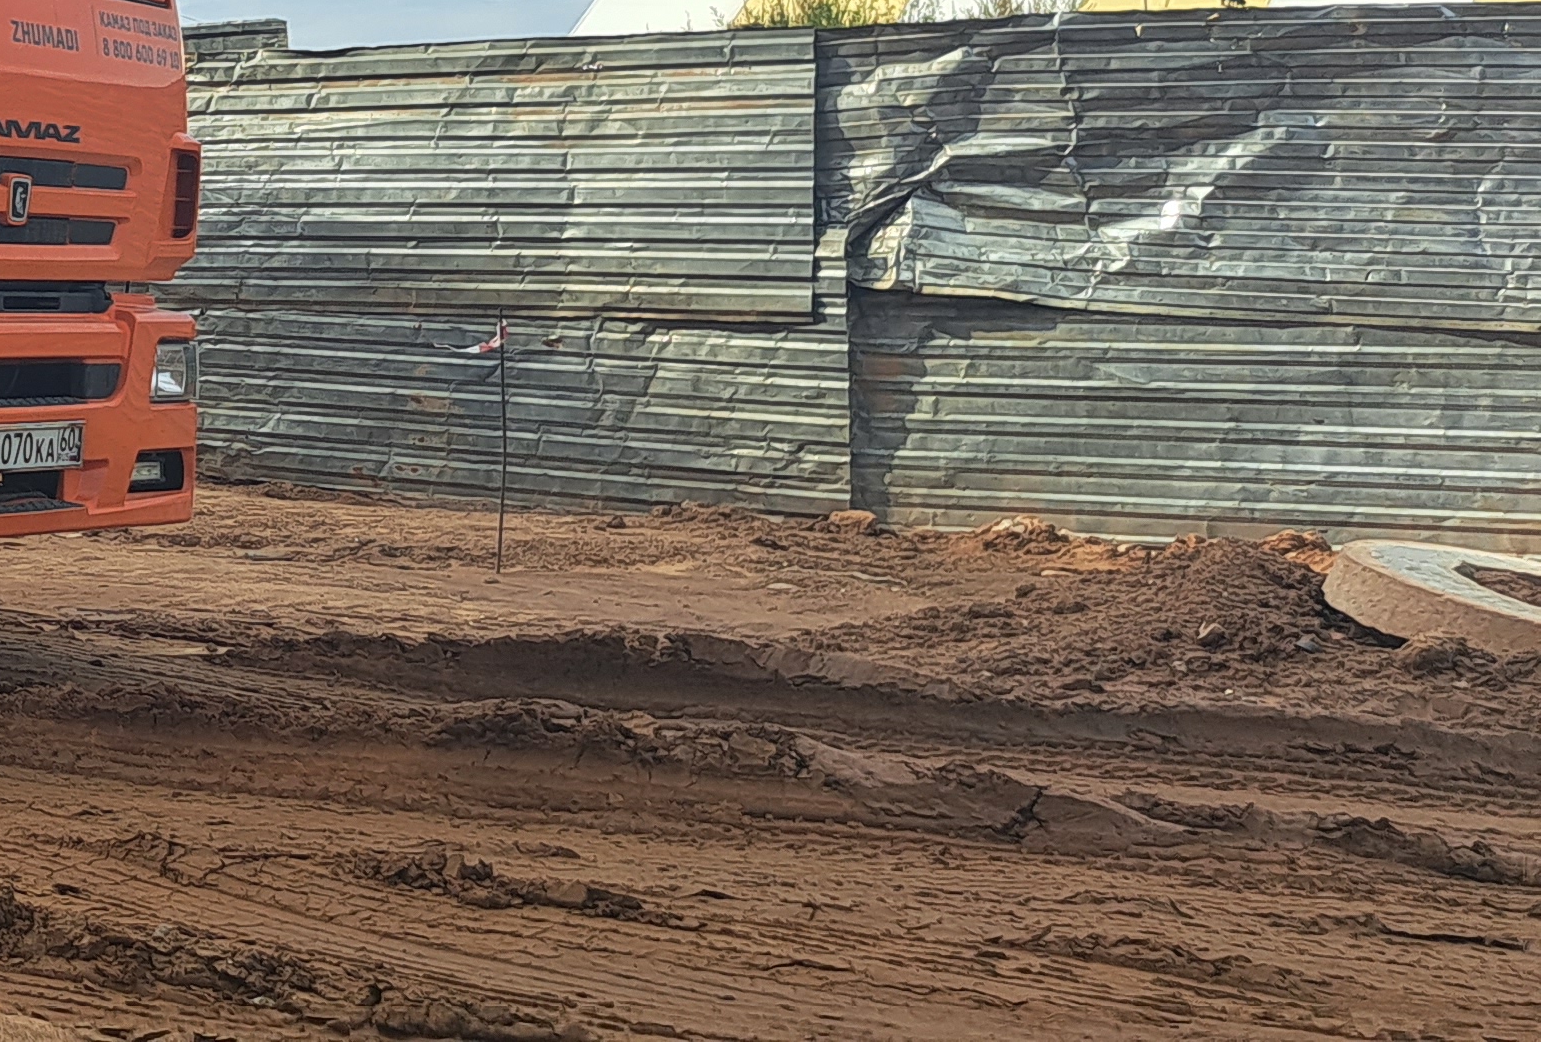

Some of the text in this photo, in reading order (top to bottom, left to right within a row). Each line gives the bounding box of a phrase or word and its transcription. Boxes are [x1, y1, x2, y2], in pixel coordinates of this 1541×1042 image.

[10, 19, 80, 52] ZHUMADI
[98, 10, 178, 42] КАМАЗ ПОД ЗАКАЗ
[102, 37, 110, 57] 8
[113, 39, 133, 61] 800
[136, 42, 154, 65] 600
[60, 426, 76, 453] 60
